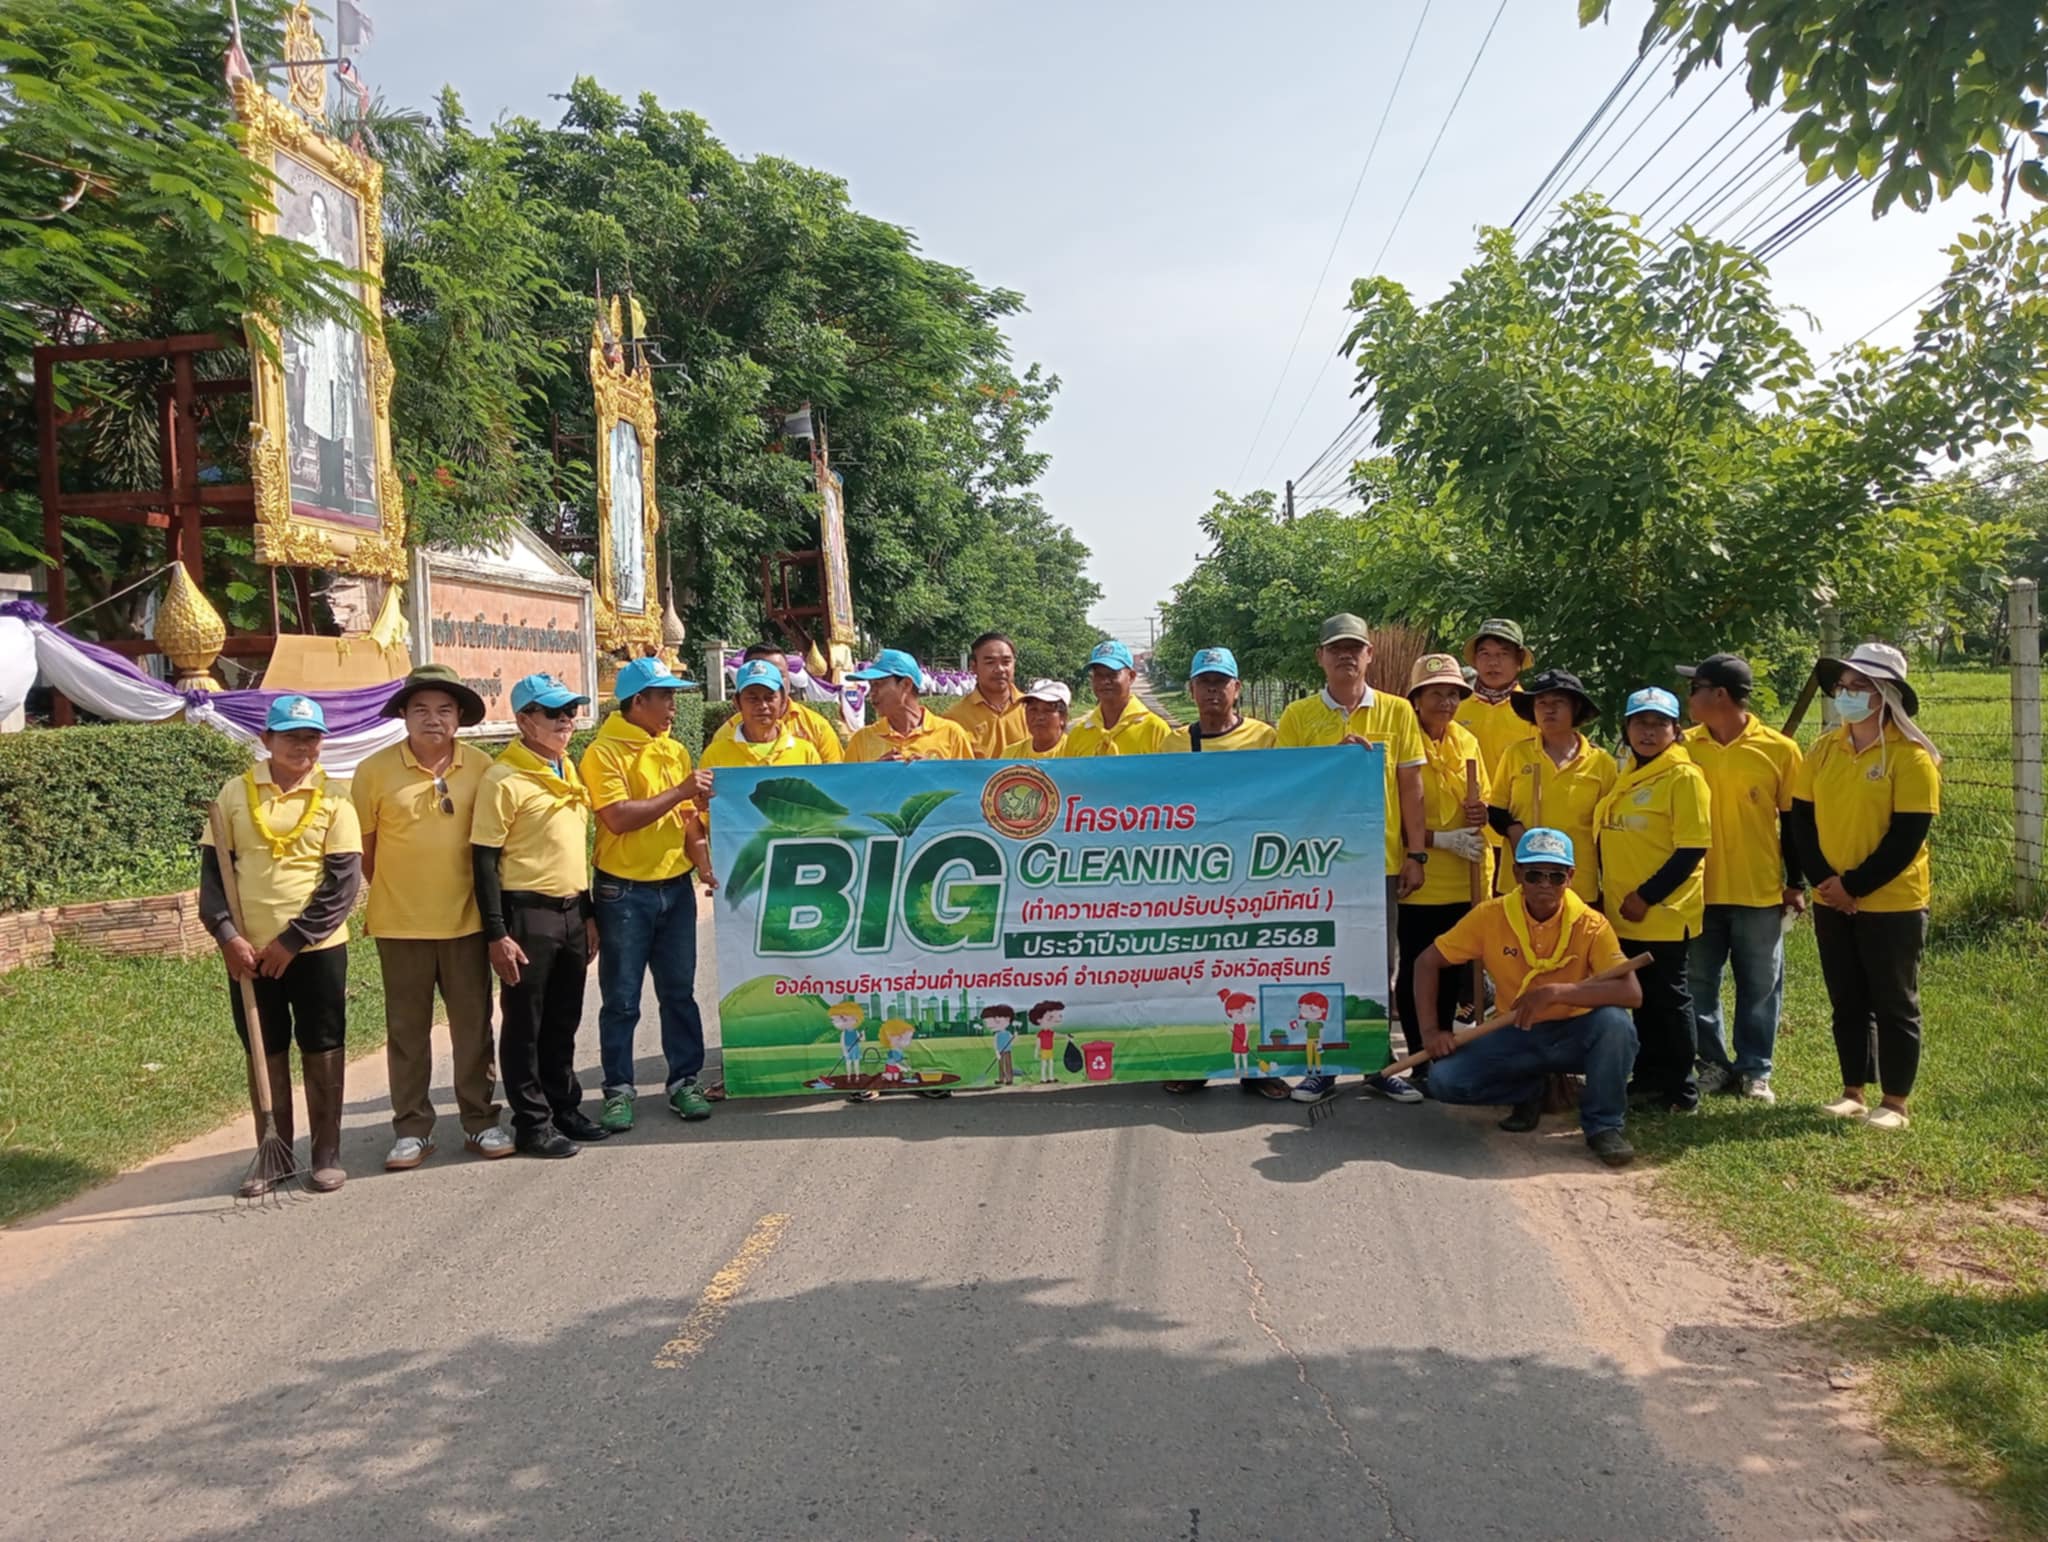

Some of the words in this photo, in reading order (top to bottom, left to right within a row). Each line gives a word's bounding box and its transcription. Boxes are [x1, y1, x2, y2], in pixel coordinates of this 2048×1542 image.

[1065, 796, 1197, 833] โครงการ
[1018, 840, 1233, 886] CLEANING
[1250, 833, 1341, 879] DAY
[756, 831, 1006, 956] BIG
[1023, 930, 1249, 957] ประจำปีงบประมาณ
[1256, 928, 1319, 947] 2568
[775, 966, 1069, 996] องค์การบริหารส่วนตำบลศรีณรงค์
[1074, 959, 1205, 988] อำเภอชุมพลบุรี
[1211, 955, 1332, 982] จังหวัดสุรินทร์
